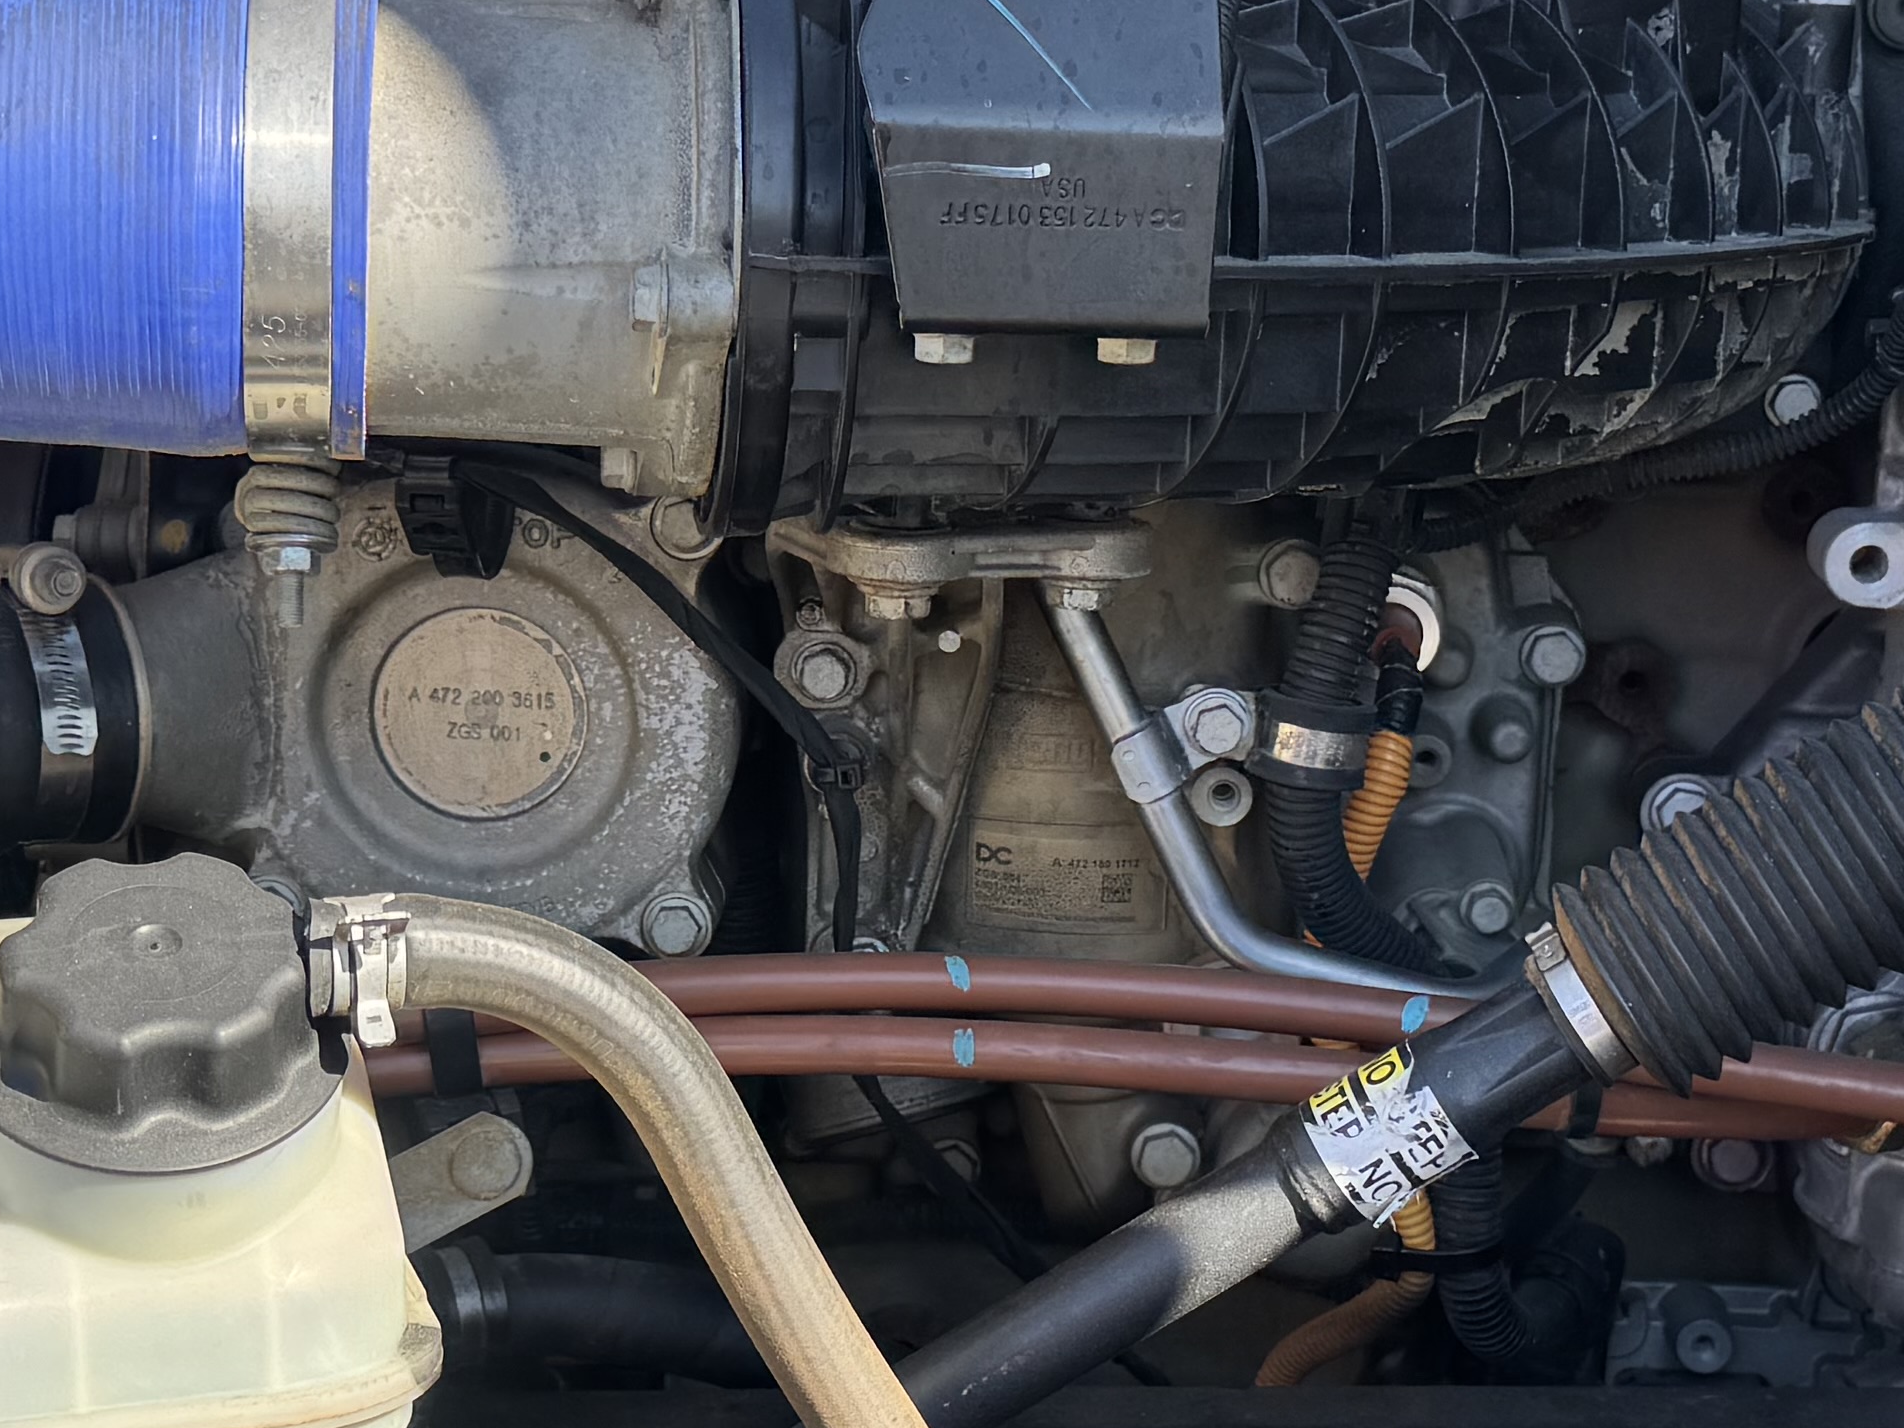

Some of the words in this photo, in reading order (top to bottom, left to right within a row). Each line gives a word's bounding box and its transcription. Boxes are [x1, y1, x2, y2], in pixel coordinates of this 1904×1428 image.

[408, 687, 421, 704] A
[429, 687, 462, 706] 472
[511, 691, 556, 710] 3615
[446, 722, 482, 741] ZGS
[975, 841, 1013, 865] DC
